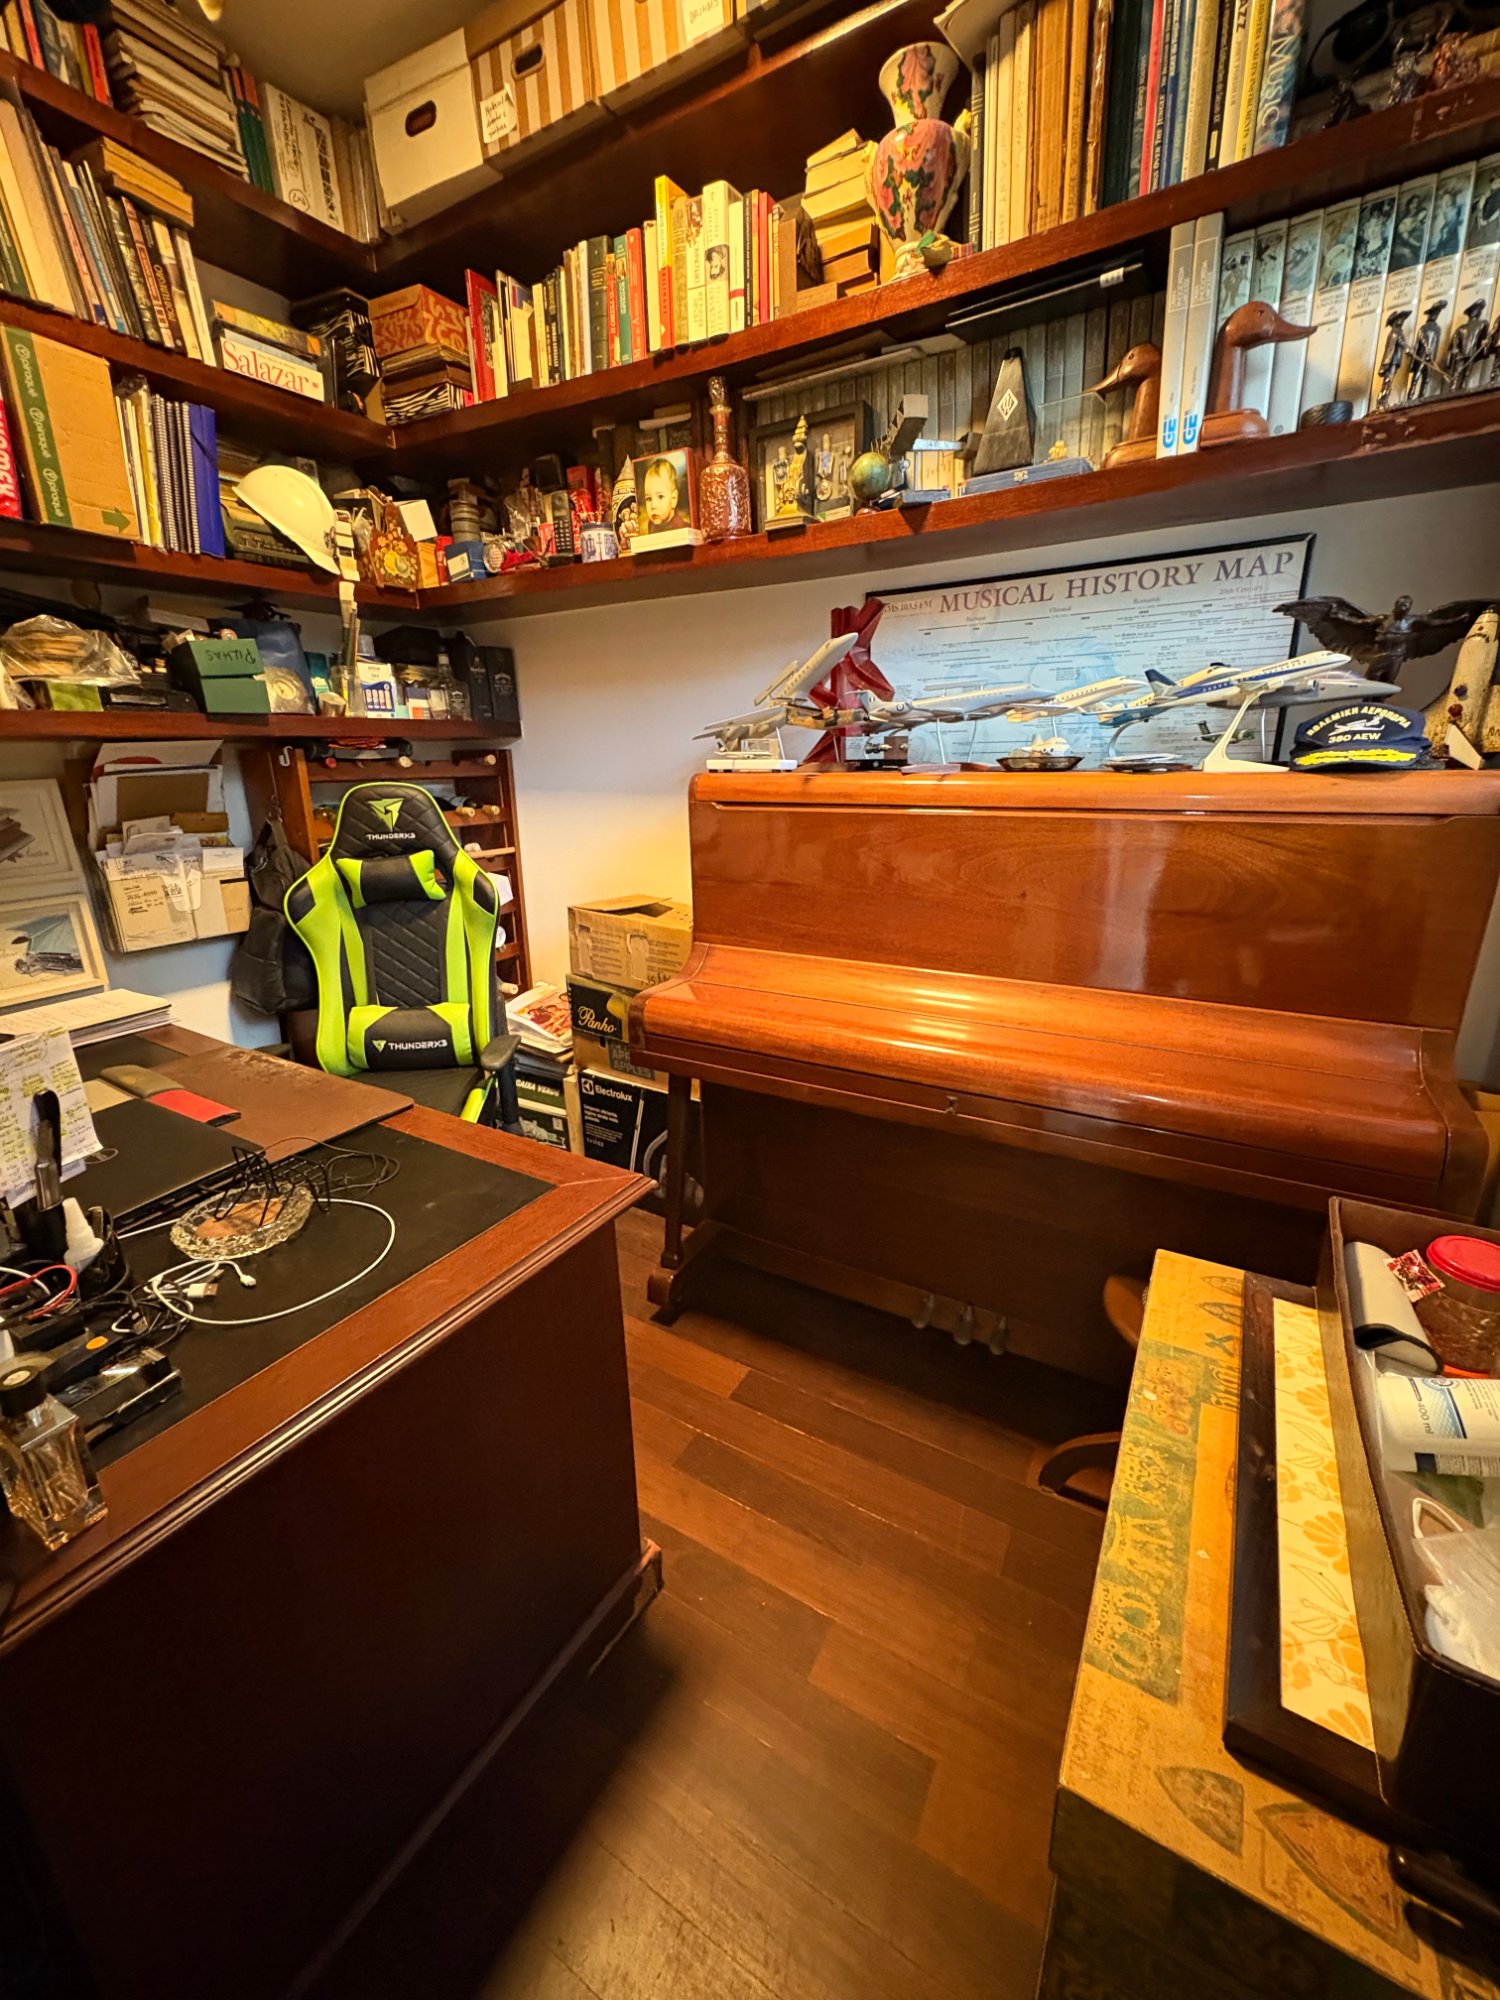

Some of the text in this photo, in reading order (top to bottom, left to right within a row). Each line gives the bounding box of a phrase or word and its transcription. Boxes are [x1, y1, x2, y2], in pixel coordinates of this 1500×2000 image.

[1261, 33, 1296, 128] MUSIC
[223, 340, 309, 394] Salazar
[940, 551, 1295, 614] MUSICAL HISTORY MAP
[205, 648, 256, 665] PILHAS
[1352, 732, 1382, 741] AEW
[576, 1005, 618, 1034] Panho
[387, 1038, 448, 1050] THUNDERX3
[595, 1084, 633, 1103] Electrolux
